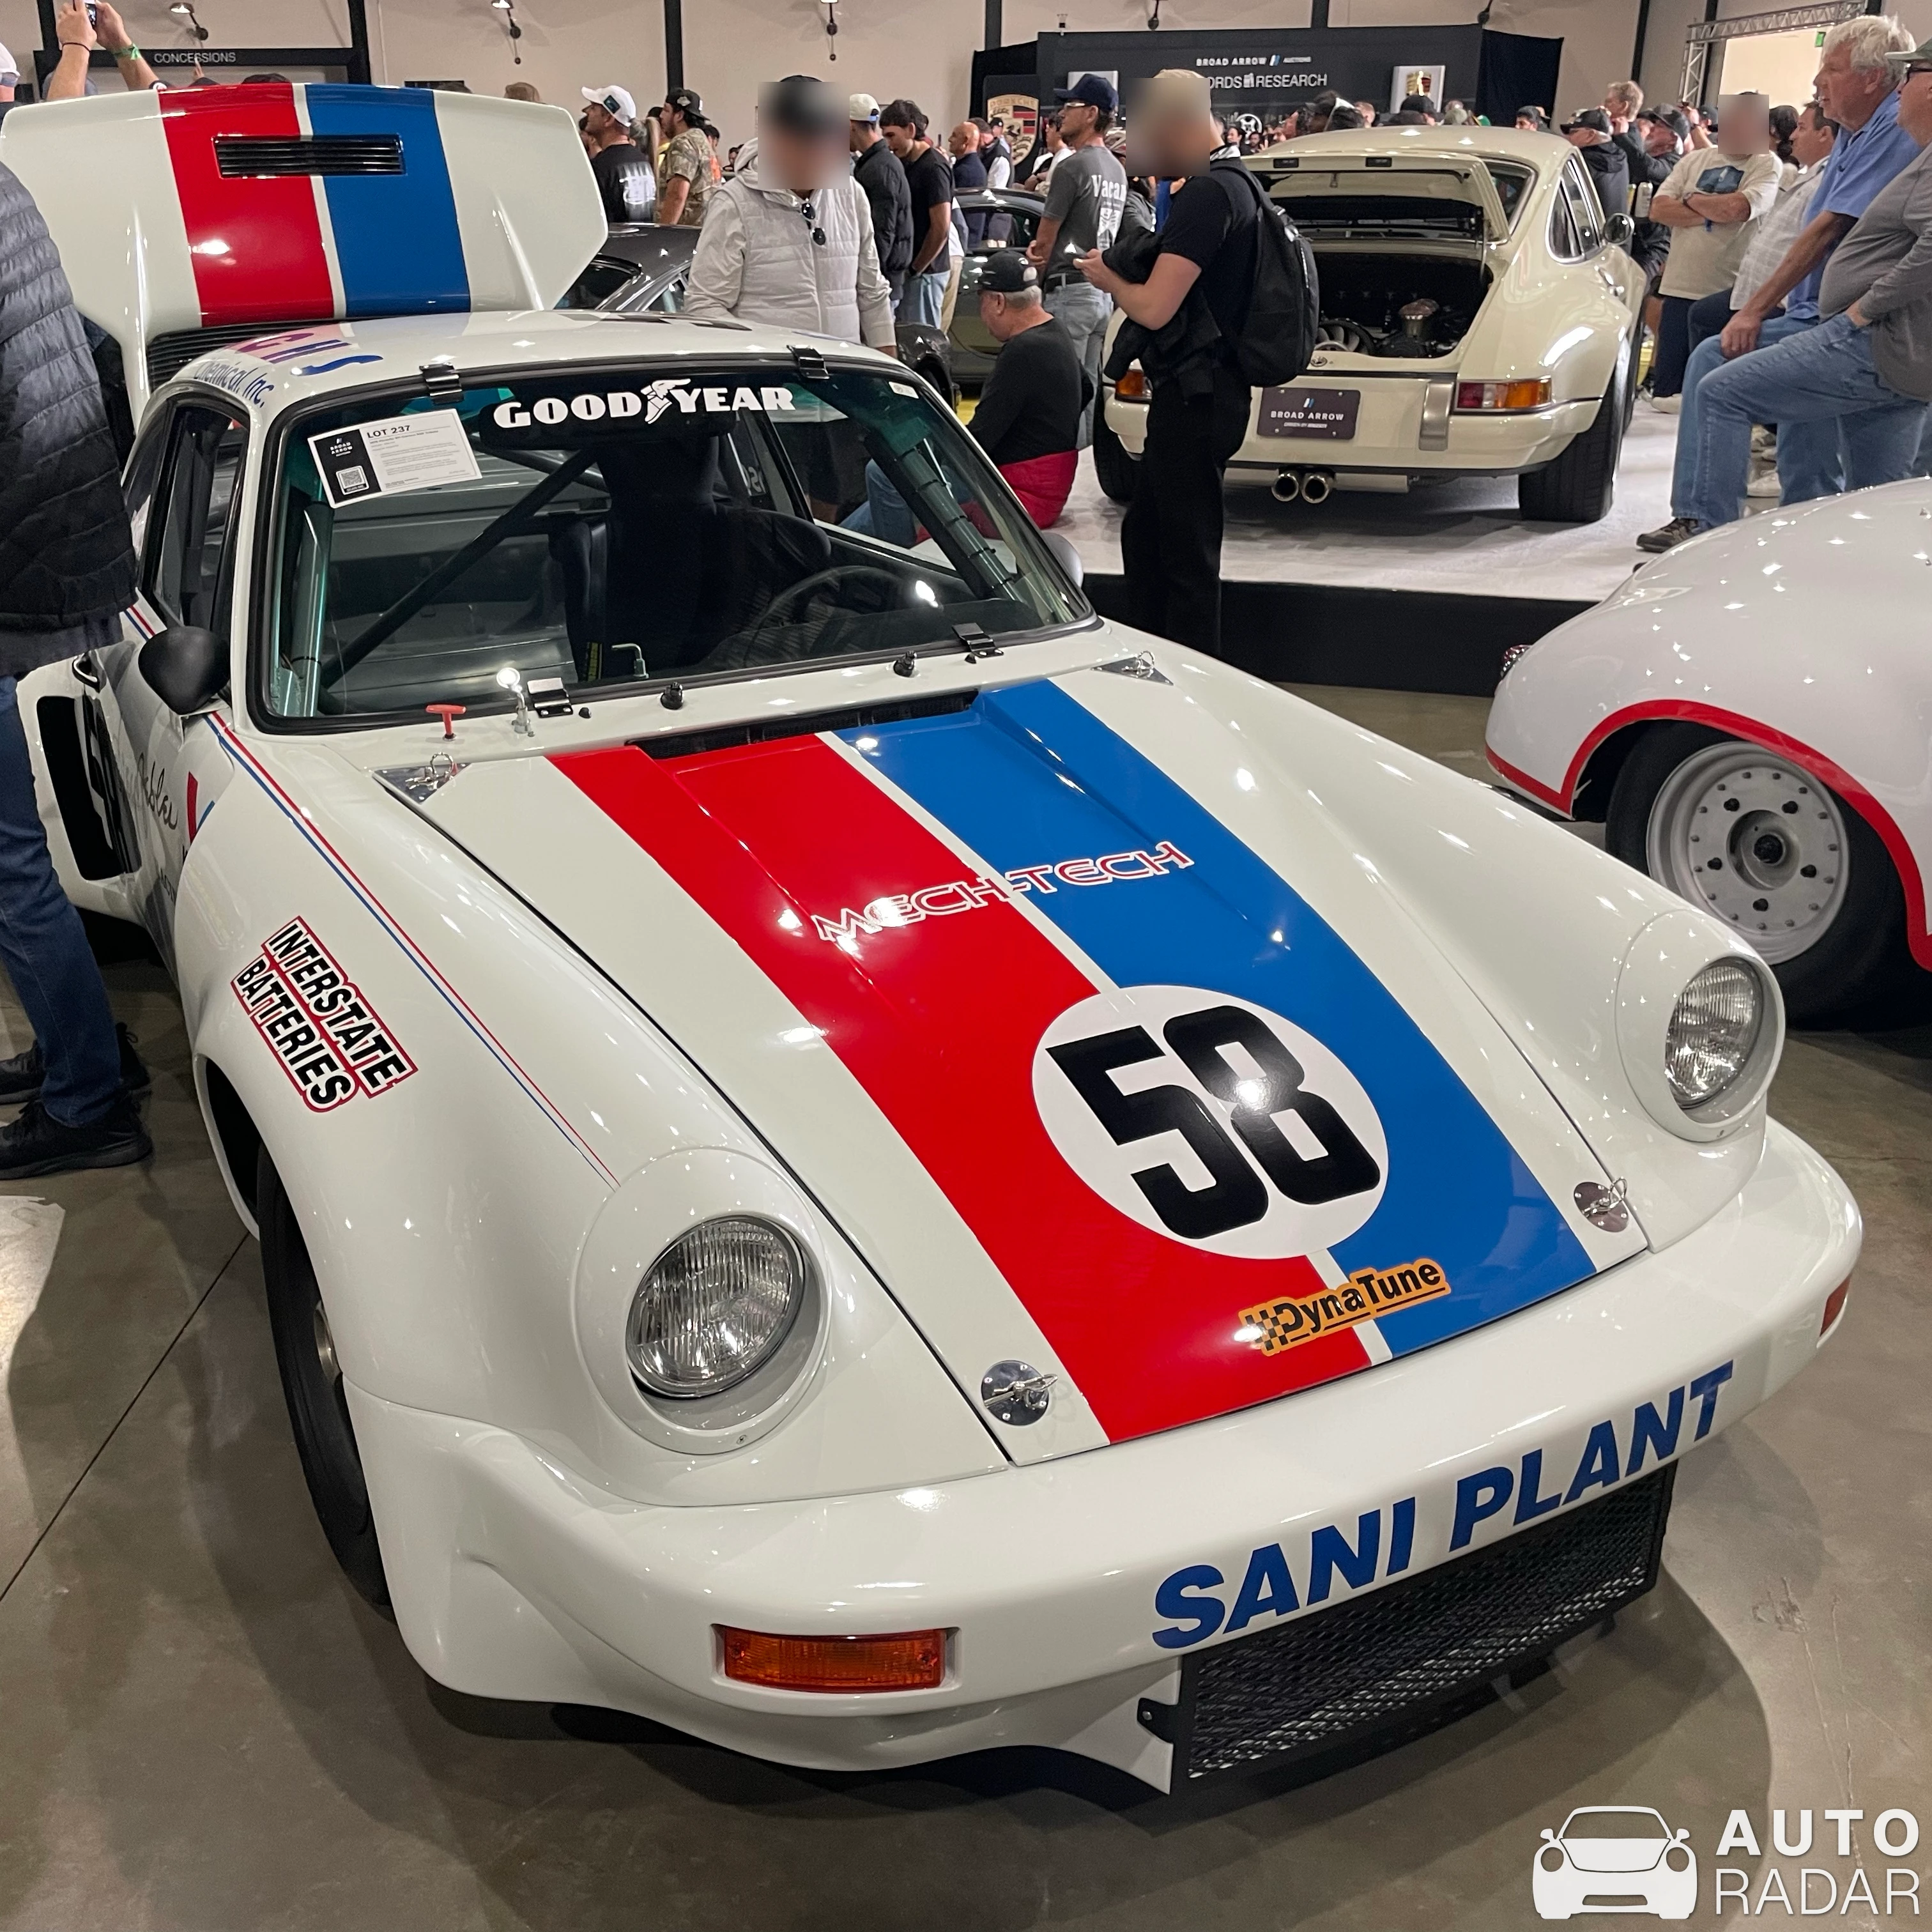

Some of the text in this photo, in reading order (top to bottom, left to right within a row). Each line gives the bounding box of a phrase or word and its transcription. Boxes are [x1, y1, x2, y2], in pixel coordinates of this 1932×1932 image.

[154, 52, 236, 63] CONCESSIONS
[1196, 57, 1267, 66] BROAD ARROW
[1255, 73, 1328, 88] RESEARCH
[242, 372, 275, 408] Inc.
[367, 428, 387, 438] LOT
[390, 425, 410, 434] 237
[1270, 410, 1344, 421] BROAD ARROW
[268, 923, 408, 1089] INTERSTATE
[236, 958, 352, 1104] BATTERIES
[1045, 1004, 1381, 1240] 58
[1272, 1263, 1441, 1334] DynaTune
[1151, 1360, 1734, 1649] SANI PLANT
